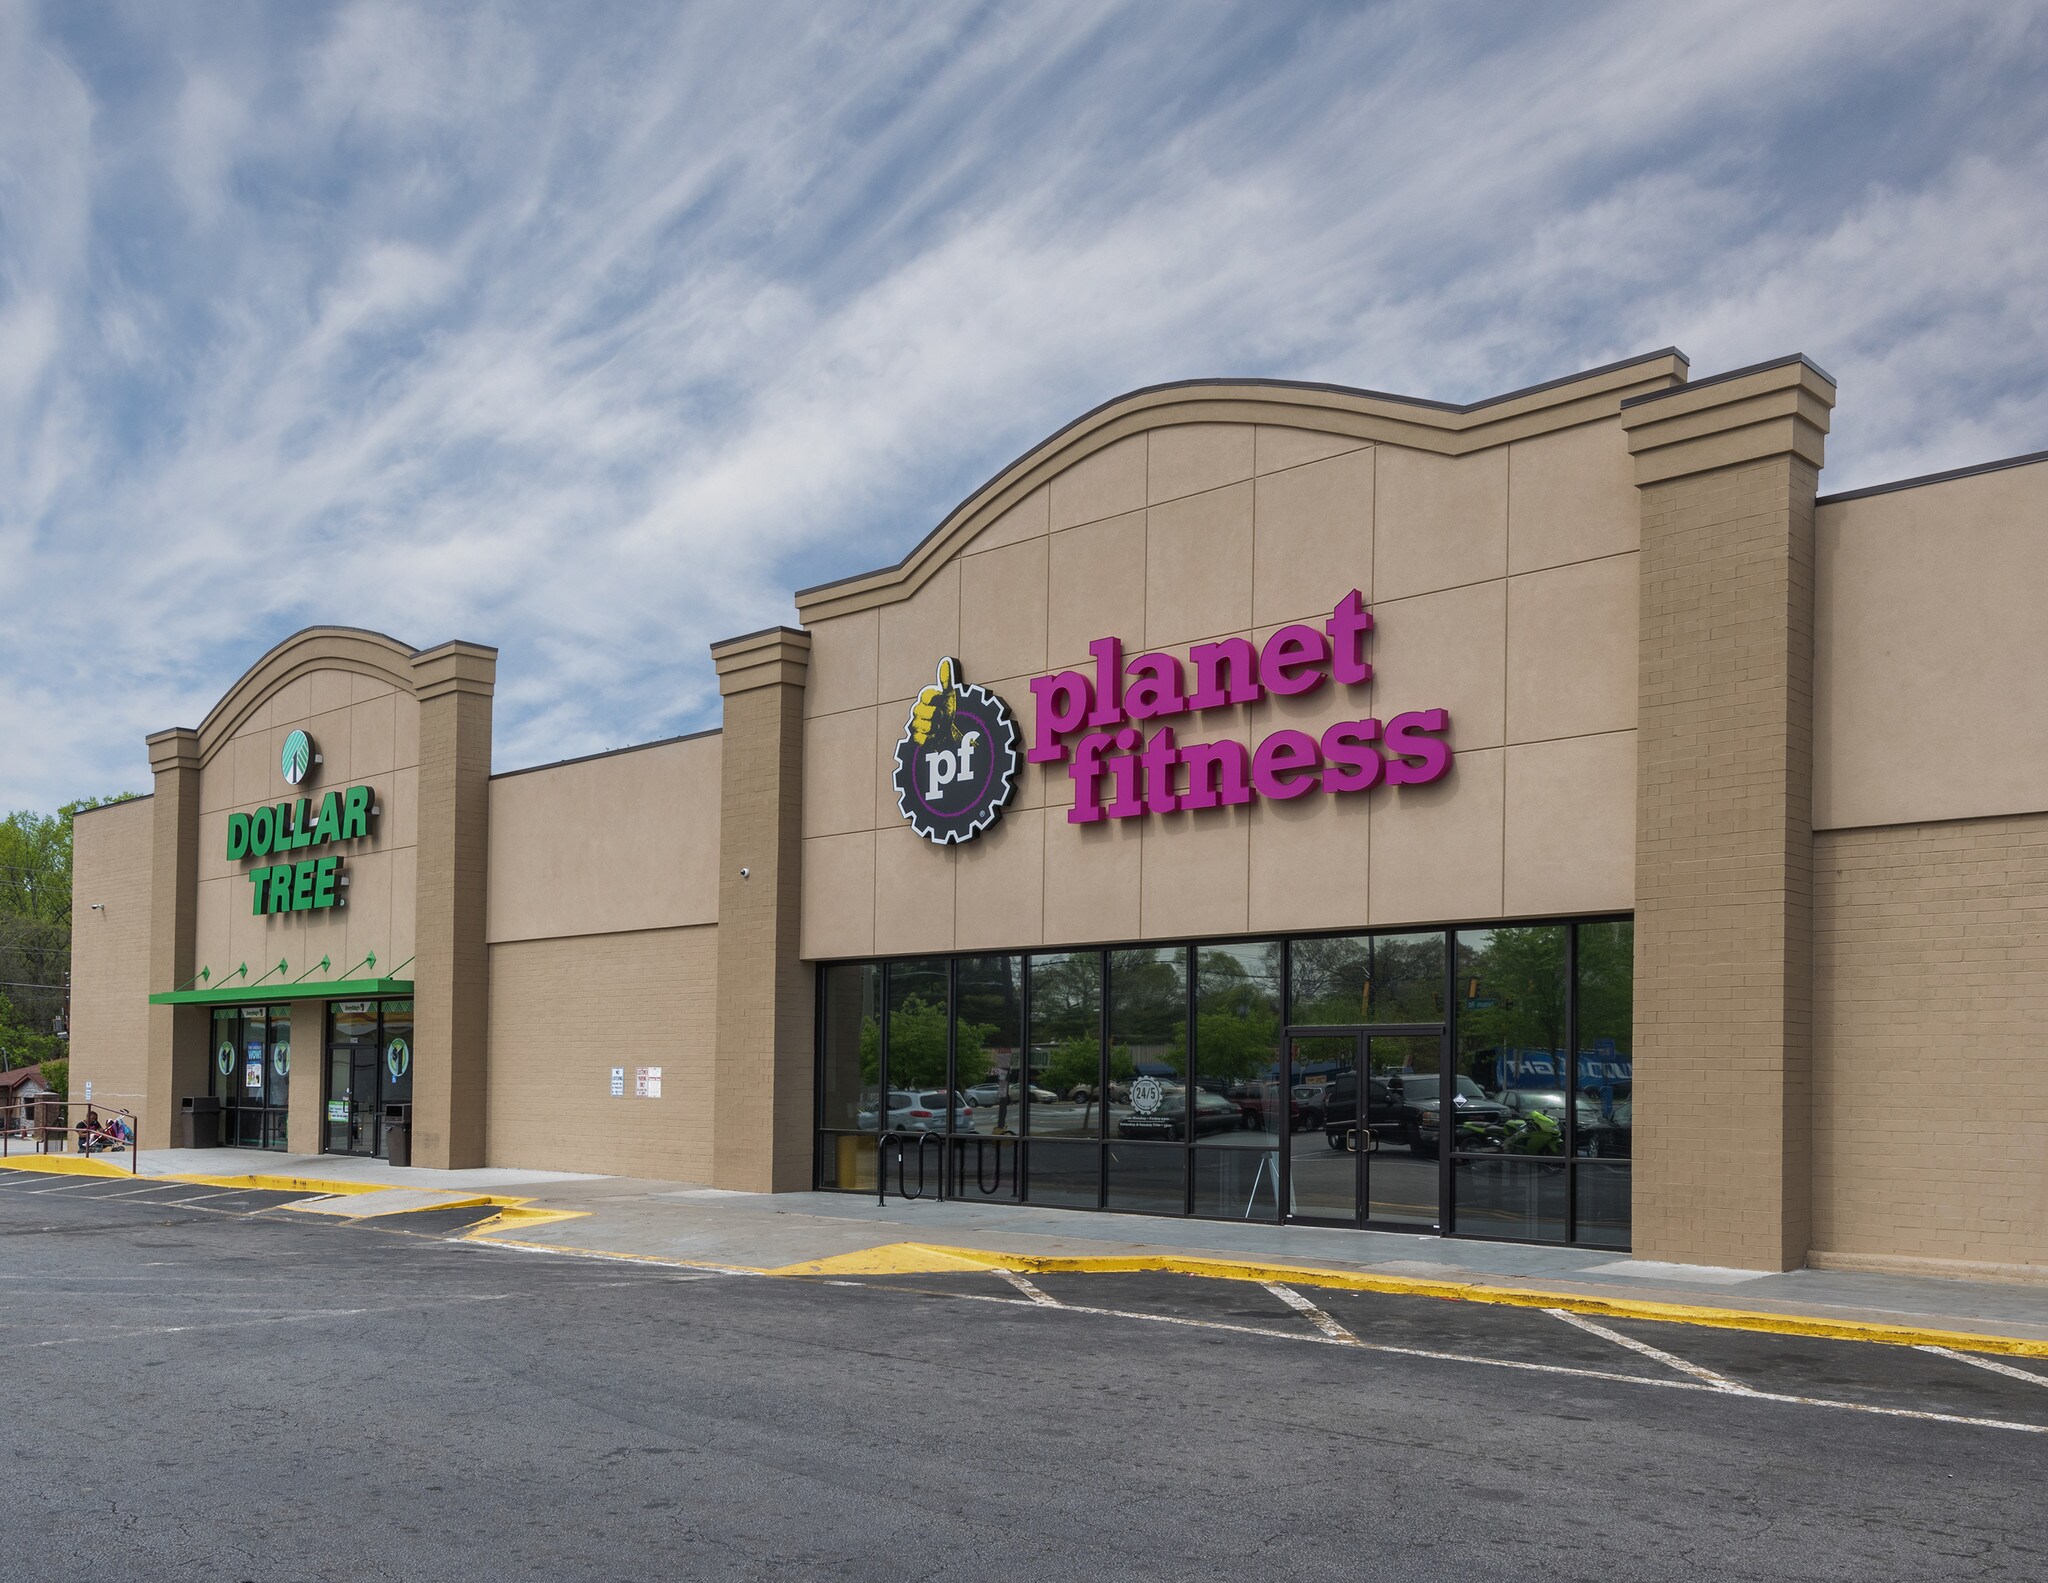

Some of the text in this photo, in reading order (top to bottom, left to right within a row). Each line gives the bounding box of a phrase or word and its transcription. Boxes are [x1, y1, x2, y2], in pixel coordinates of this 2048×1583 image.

[1027, 588, 1374, 764] planet
[925, 730, 981, 801] pf
[1067, 707, 1454, 824] fitness
[226, 785, 375, 862] DOLLAR
[248, 855, 344, 916] TREE
[1136, 1087, 1156, 1099] 24/5
